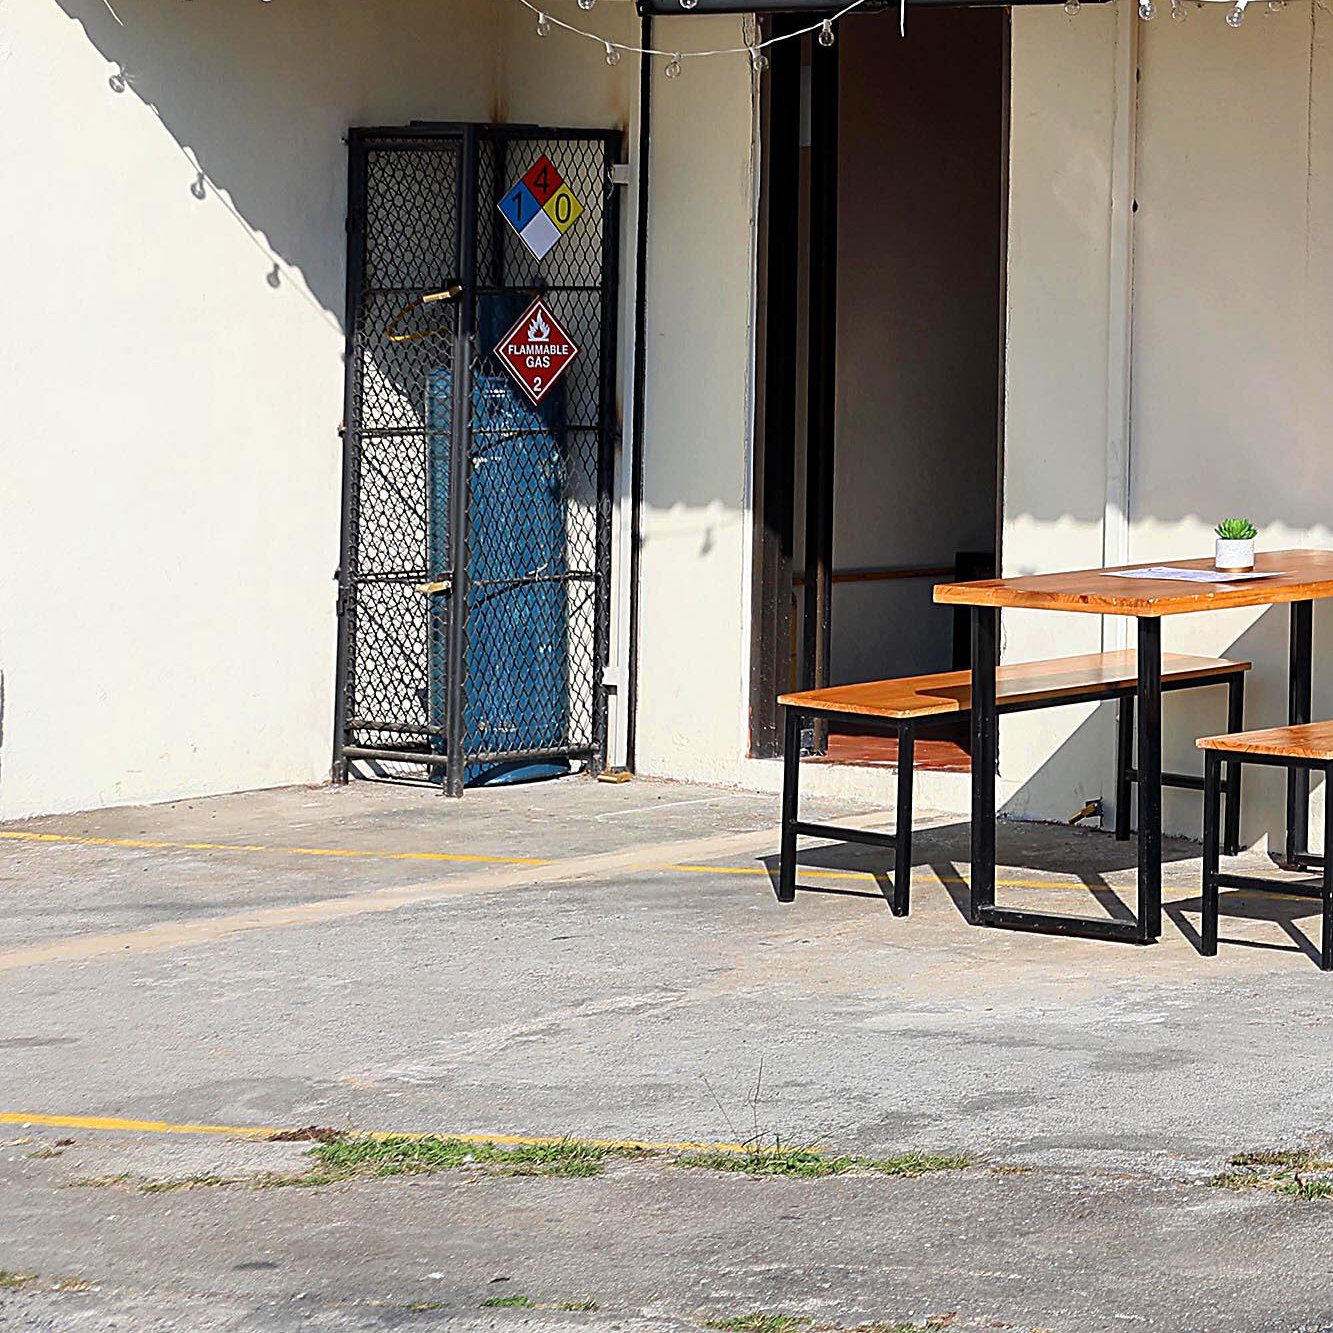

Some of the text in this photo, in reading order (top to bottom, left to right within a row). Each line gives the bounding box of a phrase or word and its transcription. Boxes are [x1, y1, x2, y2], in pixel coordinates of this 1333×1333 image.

[533, 165, 550, 195] 4
[511, 190, 523, 222] 1
[555, 192, 572, 224] 0
[508, 344, 569, 355] FLAMMABLE
[525, 355, 551, 368] GAS
[533, 376, 542, 392] 2
